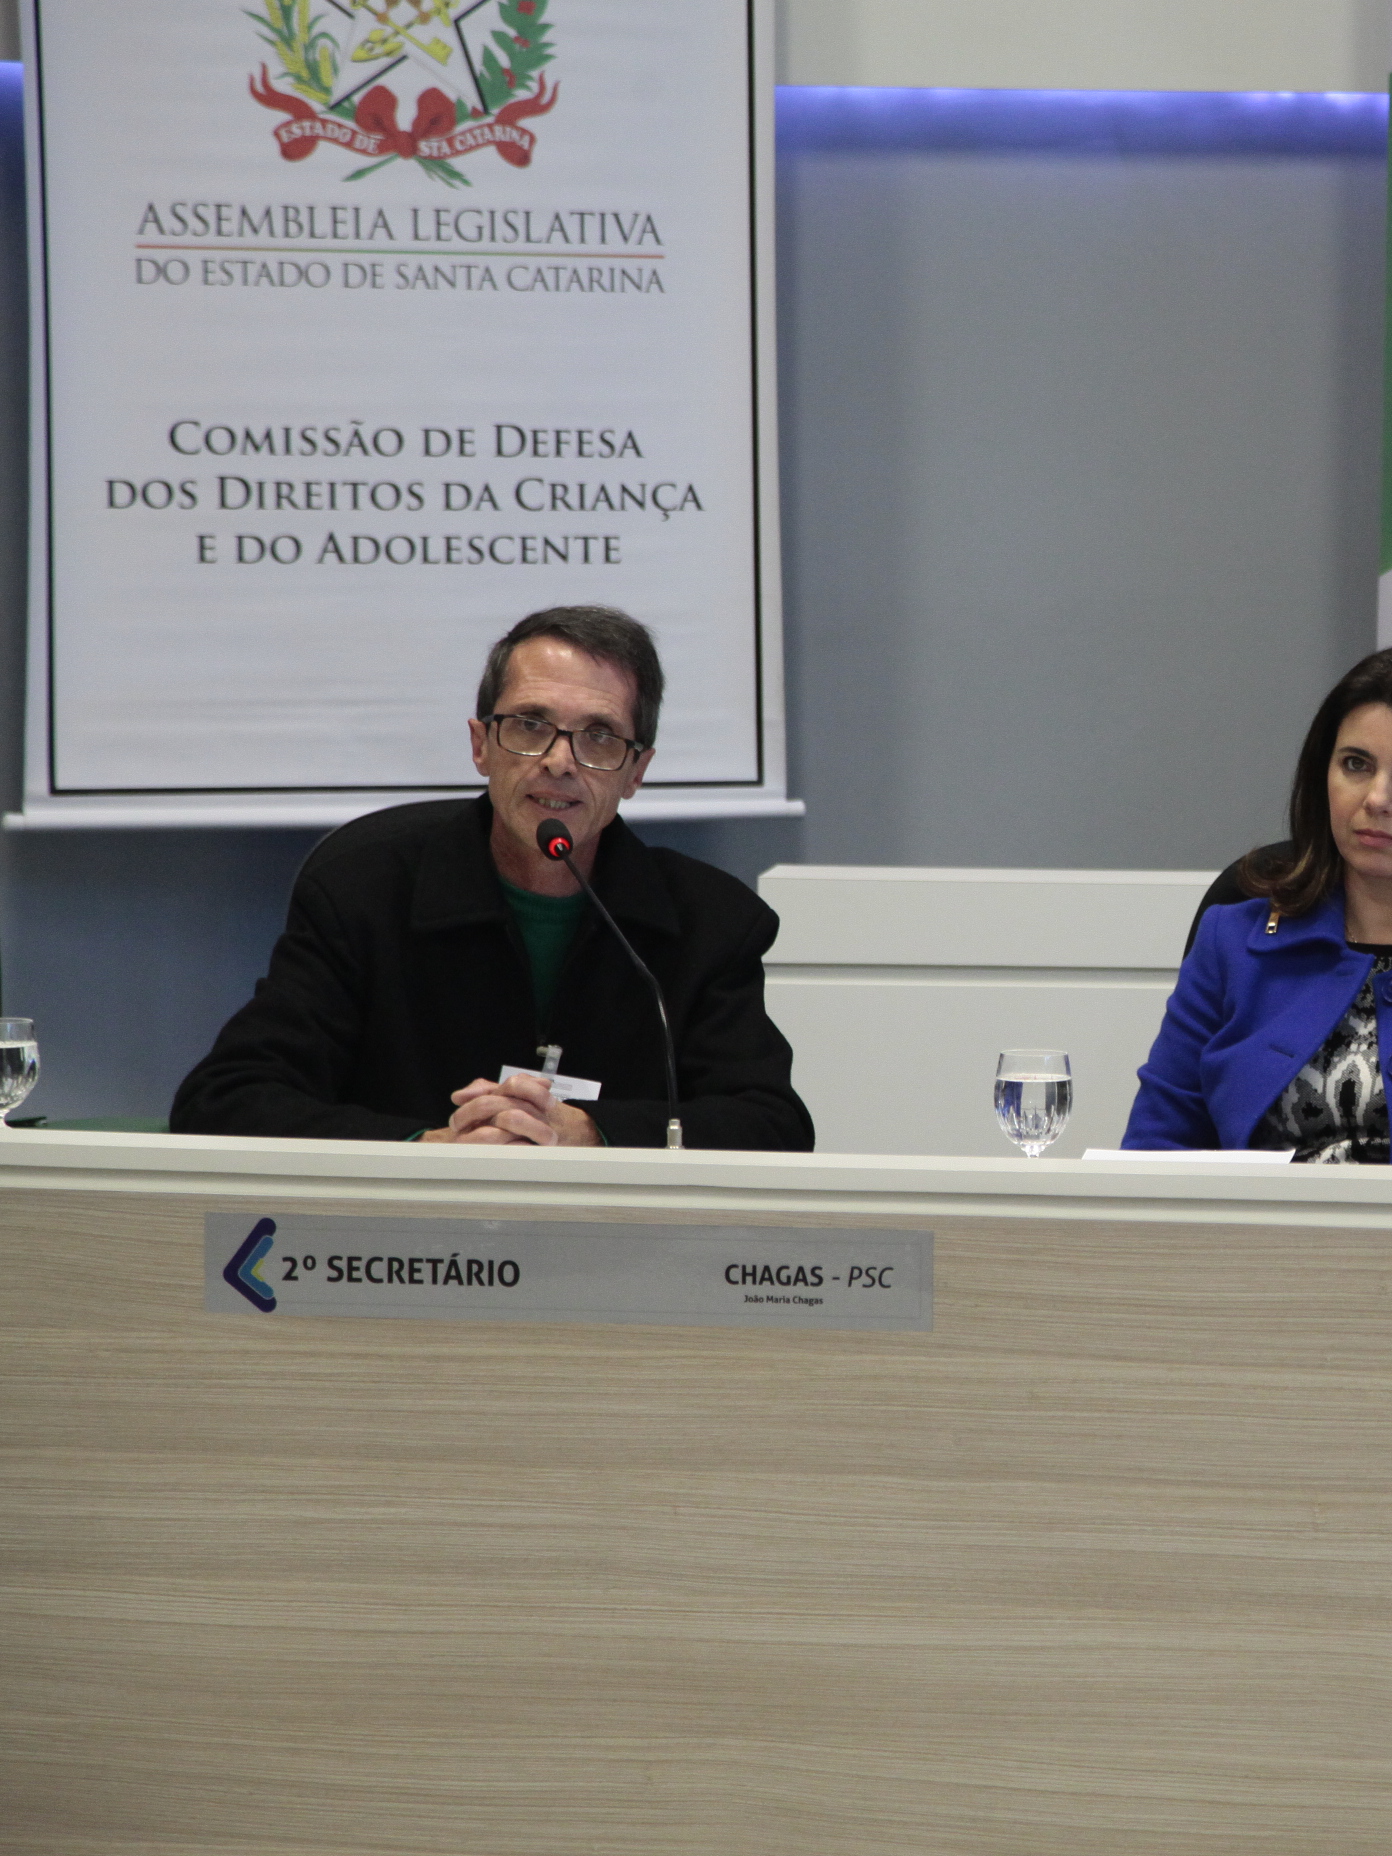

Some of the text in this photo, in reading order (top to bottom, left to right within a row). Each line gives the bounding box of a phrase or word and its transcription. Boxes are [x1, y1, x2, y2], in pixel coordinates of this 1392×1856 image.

[280, 120, 380, 154] ESTADO DE
[454, 124, 531, 151] CATARINA
[137, 201, 663, 246] ASSEMBLEIA LEGISLATIVA
[134, 256, 665, 294] DO ESTADO DE SANTA CATARINA
[167, 420, 643, 458] COMISSÃO DE DEFESA
[106, 475, 703, 521] DOS DIREITOS DA CRIANÇA
[197, 531, 619, 565] E DO ADOLESCENTE
[326, 1252, 521, 1288] SECRETÁRIO
[724, 1263, 824, 1288] CHAGAS
[847, 1265, 894, 1289] PSC
[744, 1294, 823, 1306] João Maria Chagas
